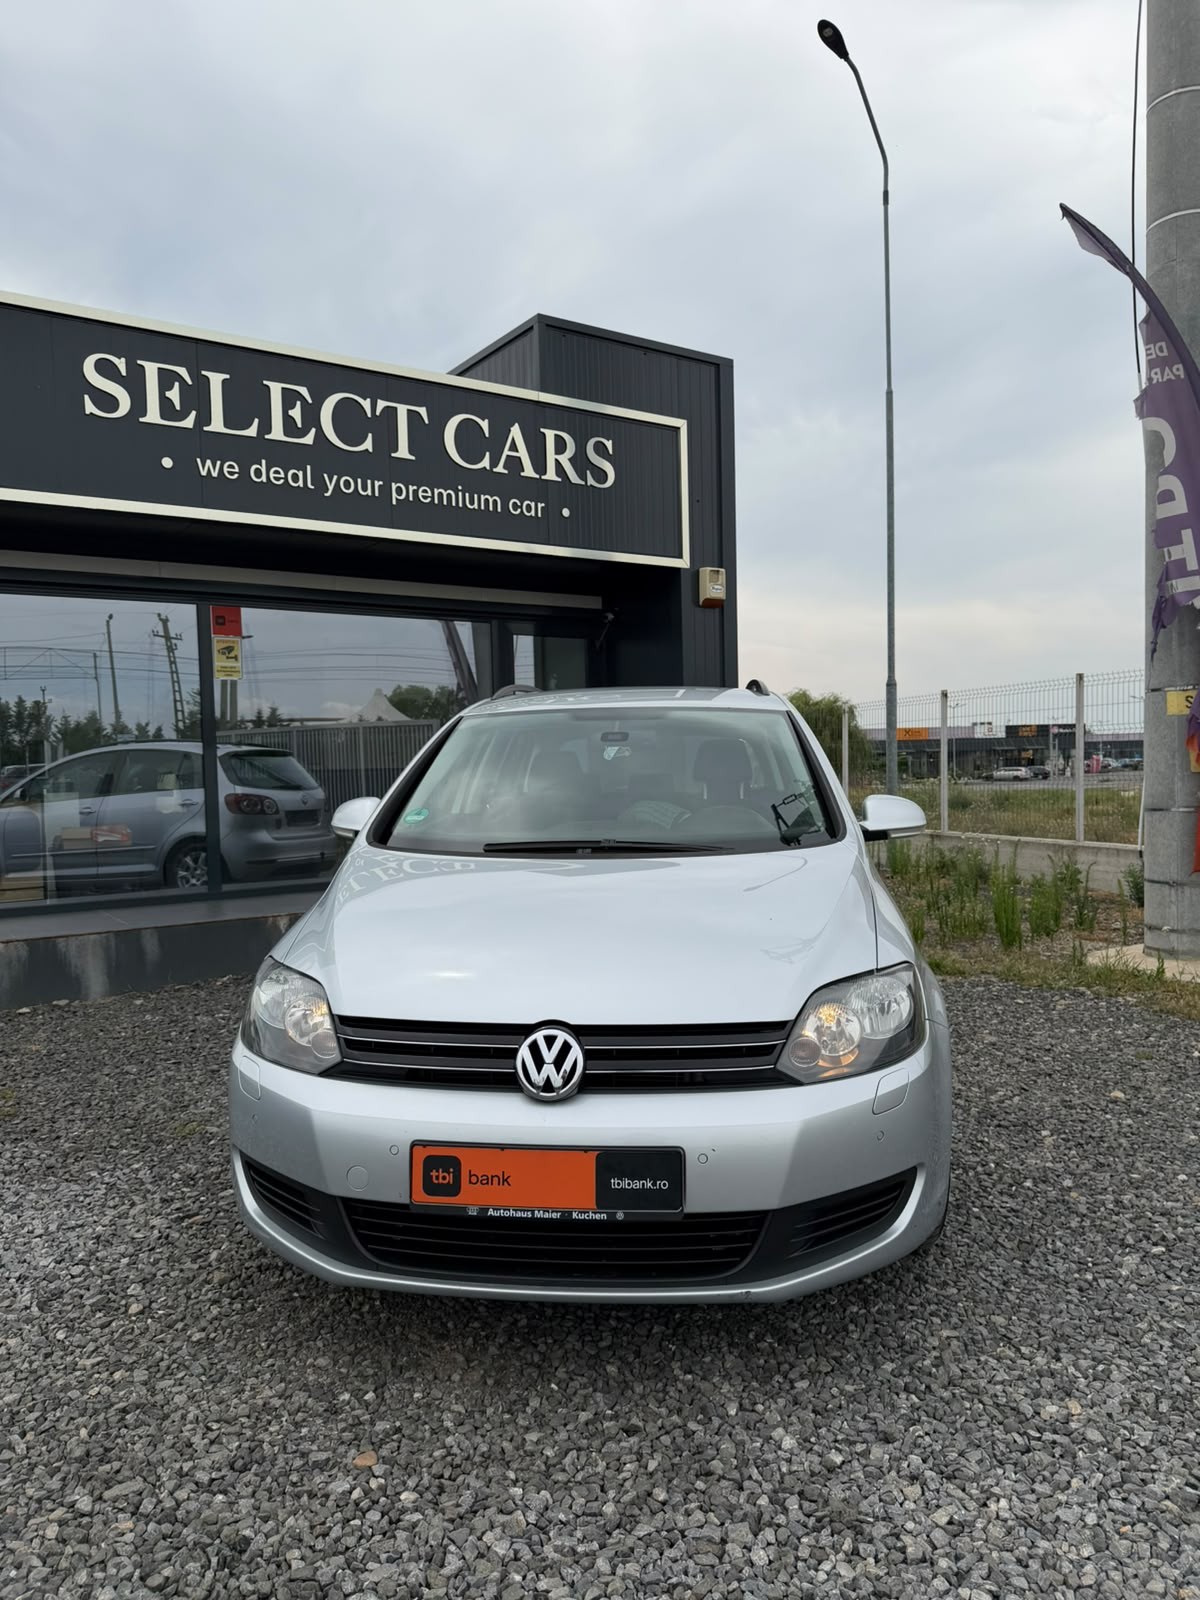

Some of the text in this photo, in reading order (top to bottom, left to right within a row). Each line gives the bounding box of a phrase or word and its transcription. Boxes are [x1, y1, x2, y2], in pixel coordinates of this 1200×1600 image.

[82, 353, 616, 489] SELECT CARS
[196, 457, 545, 518] we deal your premium car
[430, 1168, 511, 1187] tbi bank
[610, 1177, 669, 1190] tbibank.ro
[487, 1208, 607, 1220] Autohaus Maier Kuchen
